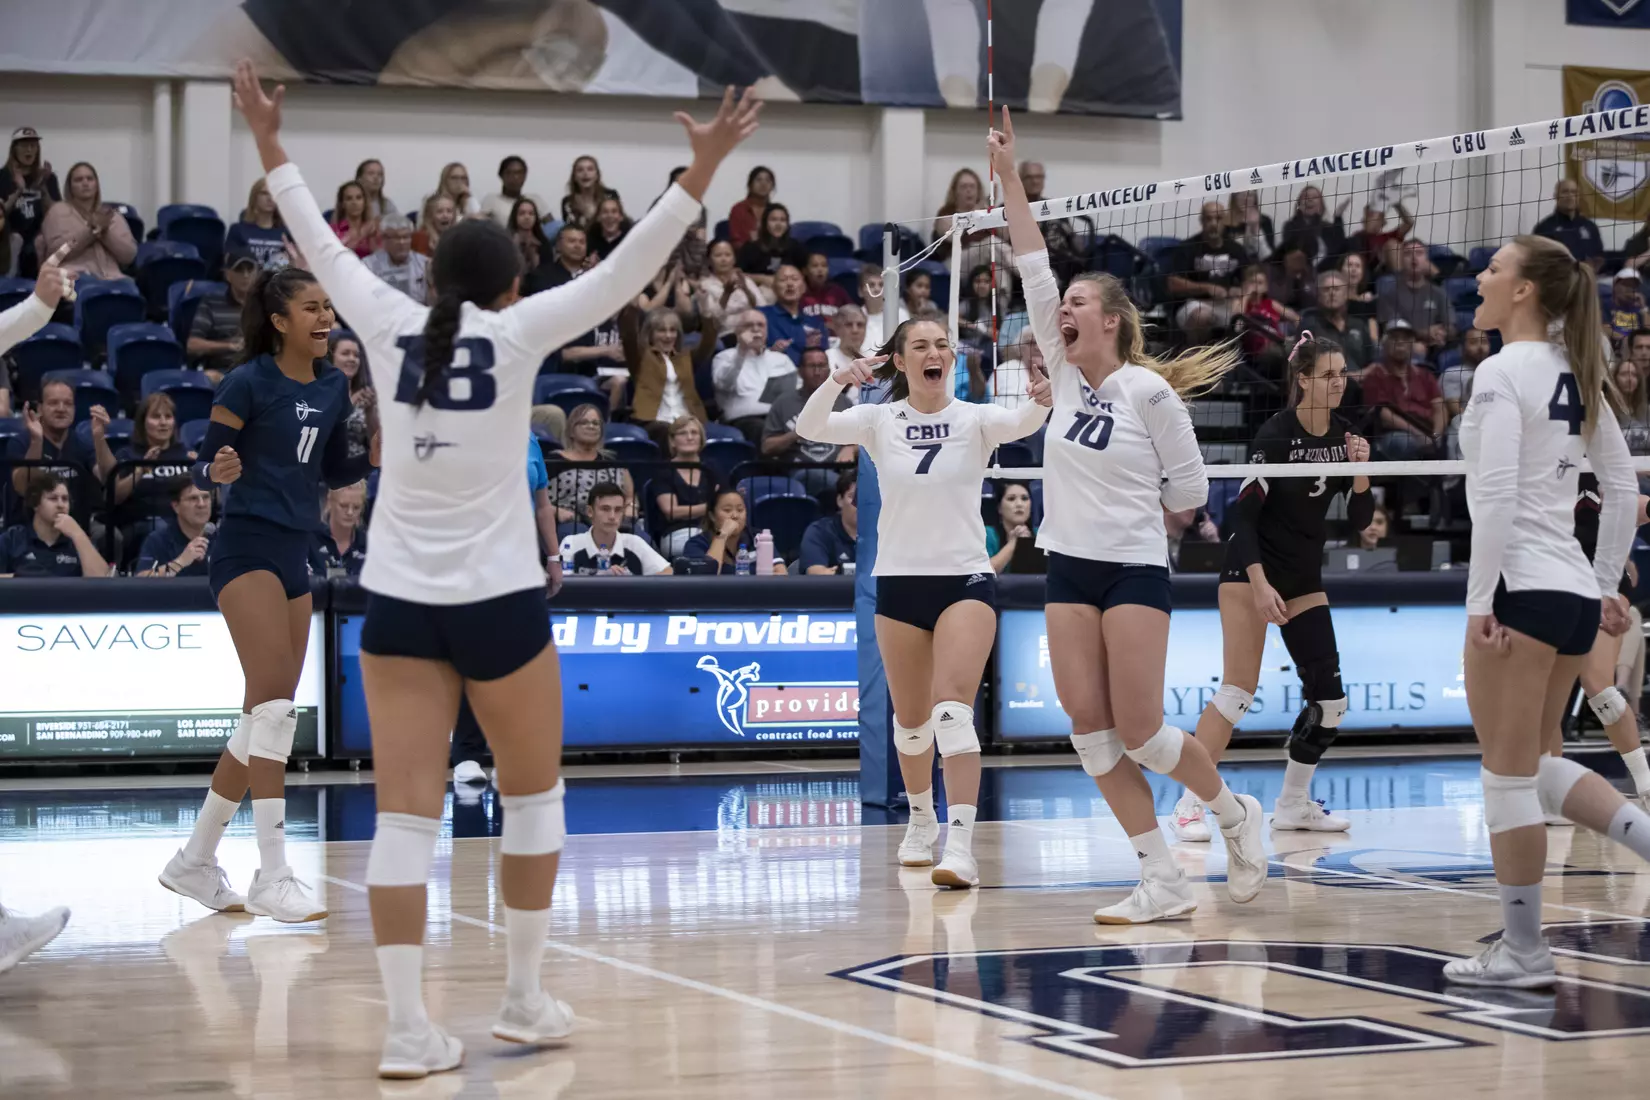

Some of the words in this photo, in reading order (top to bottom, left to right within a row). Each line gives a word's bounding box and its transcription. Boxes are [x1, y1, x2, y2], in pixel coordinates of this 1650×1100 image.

[1452, 132, 1486, 154] CBU
[1282, 146, 1394, 180] #LANCEUP
[1205, 171, 1232, 192] CBU
[1065, 183, 1158, 213] #LANCEUP
[393, 334, 497, 411] 18
[1149, 388, 1171, 406] WAC
[1548, 372, 1587, 436] 4
[905, 423, 950, 441] CBU
[1063, 410, 1115, 451] 10
[296, 426, 319, 463] 11
[910, 443, 943, 475] 7
[1308, 475, 1328, 498] 3
[17, 623, 202, 652] SAVAGE
[592, 615, 651, 654] by
[36, 722, 77, 731] RIVERSIDE
[177, 719, 194, 729] LOS
[195, 718, 232, 728] ANGELES
[177, 729, 195, 738] SAN
[196, 728, 224, 738] DIEGO
[755, 731, 803, 741] contract
[807, 729, 833, 739] food
[36, 731, 54, 741] SAN
[55, 730, 108, 740] BERNARDINO
